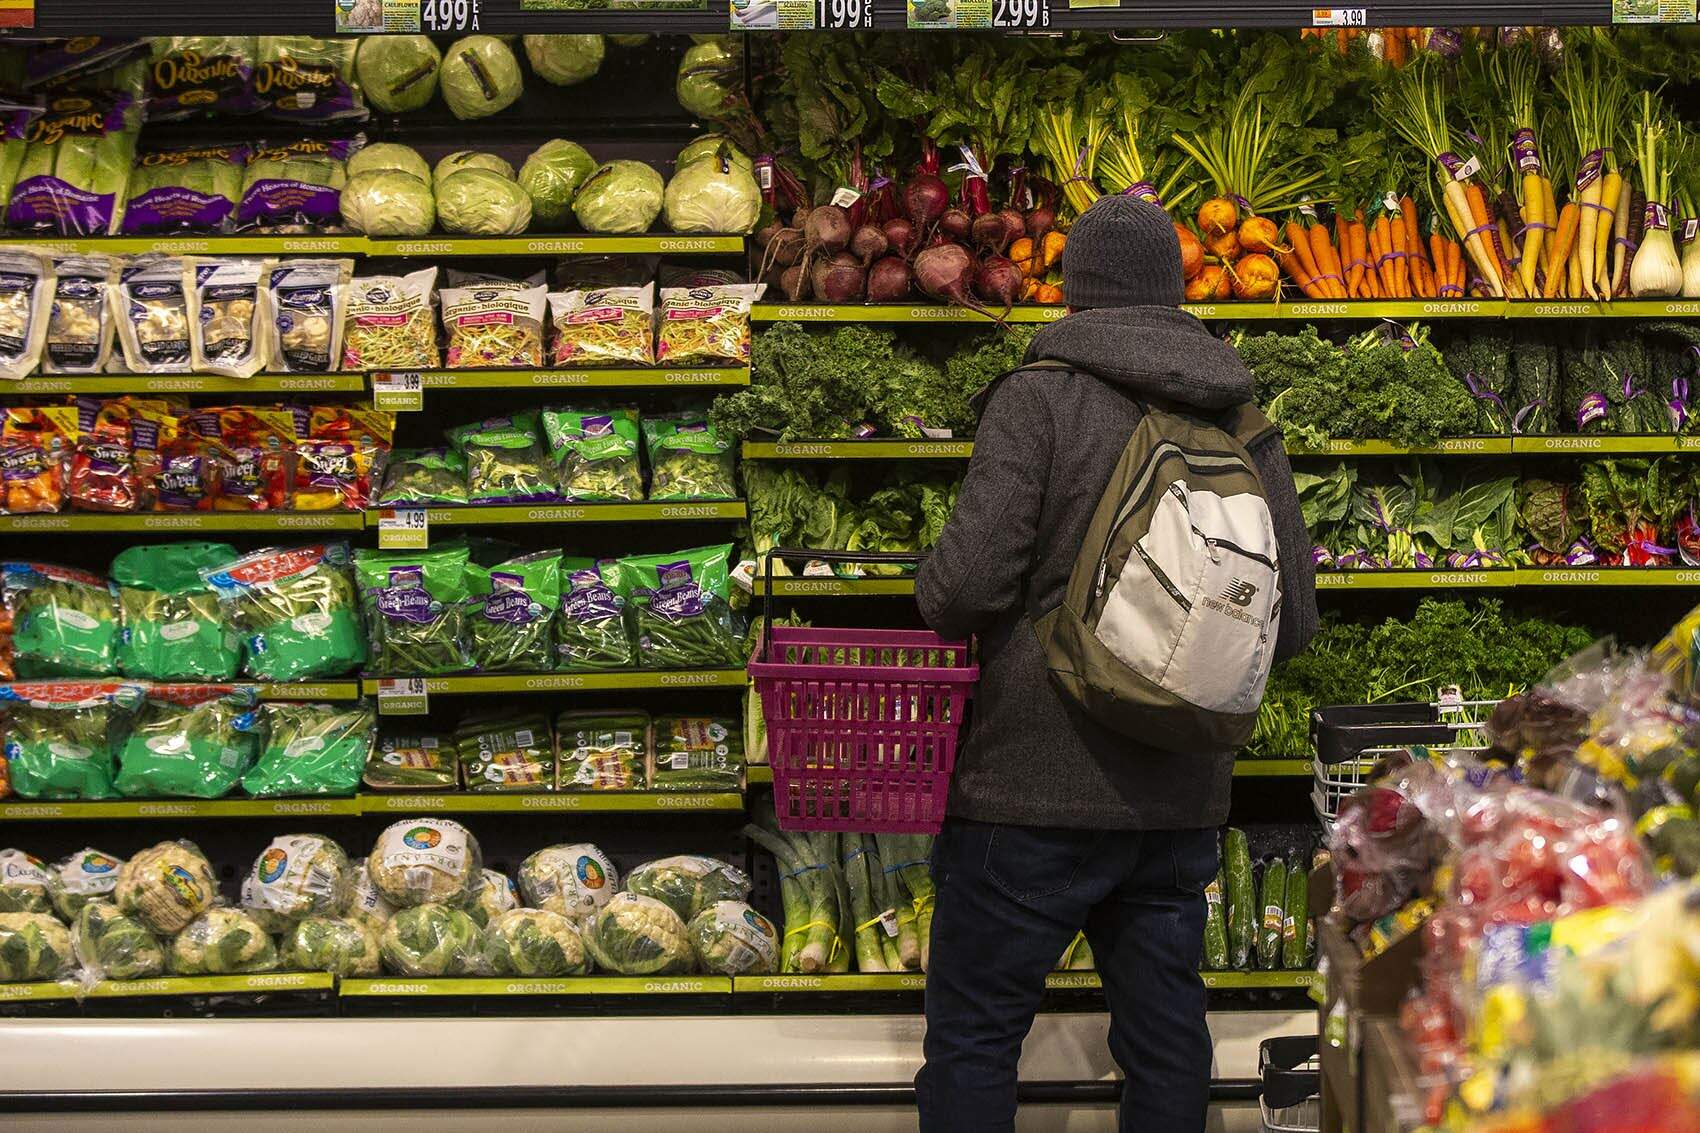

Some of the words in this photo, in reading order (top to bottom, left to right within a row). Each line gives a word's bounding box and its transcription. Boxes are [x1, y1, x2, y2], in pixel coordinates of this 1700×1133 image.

[423, 0, 468, 31] 4.99
[820, 0, 861, 28] 1.99
[993, 0, 1038, 27] 2.99
[283, 240, 340, 250] ORGANIC
[396, 243, 453, 253] ORGANIC
[527, 241, 584, 251] ORGANIC
[659, 240, 716, 250] ORGANIC
[481, 302, 529, 312] biologique
[1291, 305, 1348, 314] ORGANIC
[1423, 303, 1479, 313] ORGANIC
[1534, 305, 1590, 315] ORGANIC
[1666, 305, 1700, 313] ORGA
[778, 308, 835, 318] ORGANIC
[910, 308, 967, 318] ORGANIC
[532, 374, 588, 384] ORGANIC
[664, 373, 721, 383] ORGANIC
[16, 380, 72, 391] ORGANIC
[147, 379, 204, 390] ORGANIC
[280, 379, 336, 389] ORGANIC
[908, 444, 965, 453] ORGANIC
[1544, 439, 1601, 449] ORGANIC
[775, 445, 832, 454] ORGANIC
[528, 509, 585, 520] ORGANIC
[661, 506, 718, 517] ORGANIC
[12, 517, 70, 528] ORGANIC
[145, 517, 201, 528] ORGANIC
[277, 516, 335, 527] ORGANIC
[1430, 574, 1488, 583] ORGANIC
[1542, 572, 1600, 582] ORGANIC
[784, 582, 841, 591] ORGANIC
[526, 678, 584, 688] ORGANIC
[660, 673, 718, 685] ORGANIC
[271, 687, 328, 698] ORGANIC
[383, 701, 423, 709] ORGANIC
[386, 797, 444, 807] ORGANIC
[522, 797, 579, 807] ORGANIC
[656, 796, 715, 807] ORGANIC
[5, 806, 62, 817] ORGANIC
[139, 805, 197, 815] ORGANIC
[273, 803, 331, 813] ORGANIC
[110, 981, 169, 991] ORGANIC
[247, 977, 305, 987] ORGANIC
[644, 982, 703, 992] ORGANIC
[763, 979, 821, 987] ORGANIC
[369, 983, 428, 993] ORGANIC
[506, 983, 566, 993] ORGANIC
